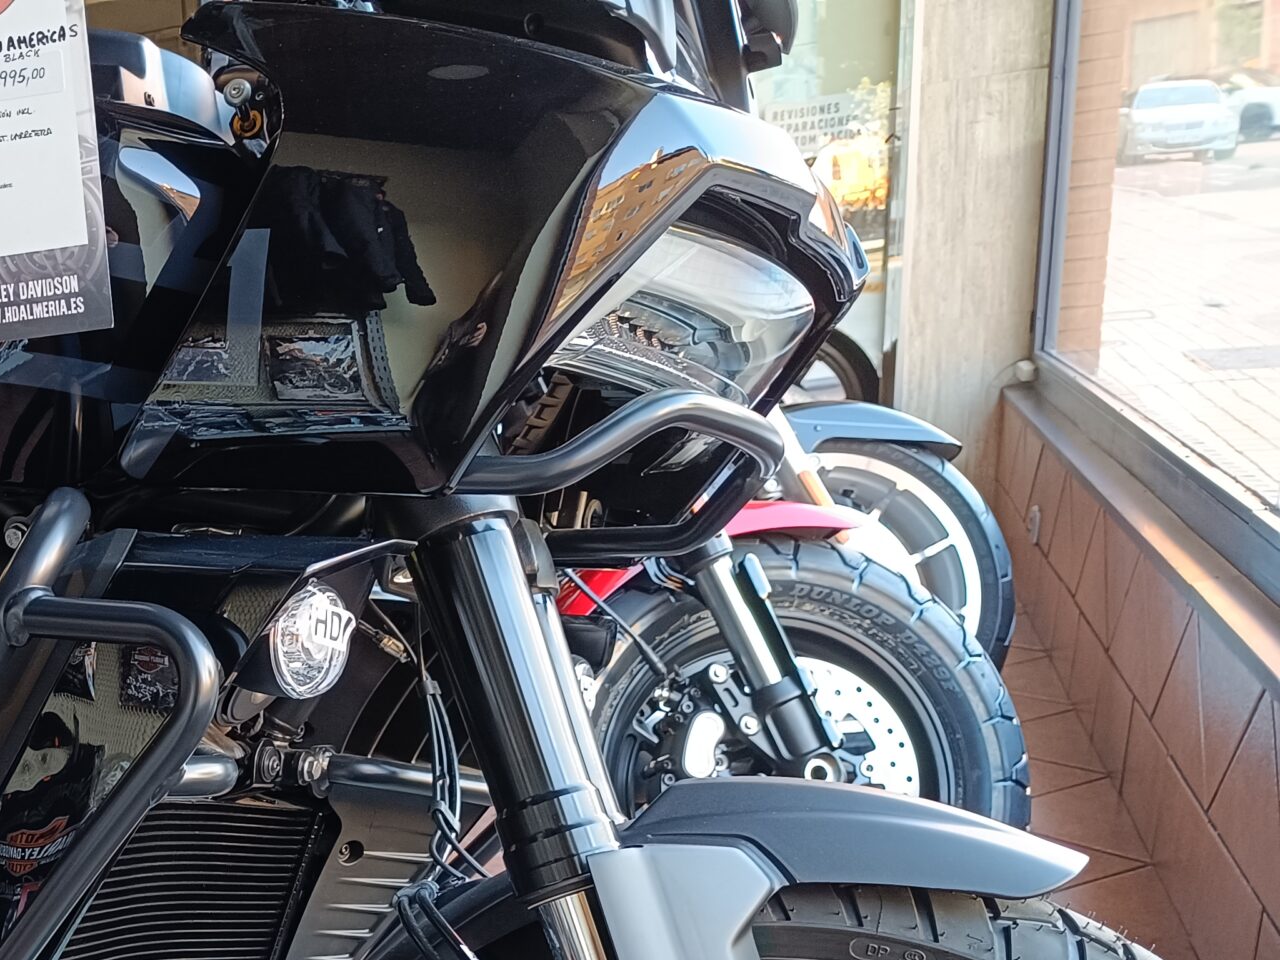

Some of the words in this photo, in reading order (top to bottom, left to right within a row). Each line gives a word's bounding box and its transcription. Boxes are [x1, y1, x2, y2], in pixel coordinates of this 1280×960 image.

[6, 25, 66, 51] AMERICA
[68, 24, 79, 38] S
[3, 48, 41, 63] BLACK
[19, 275, 79, 300] DAVIDSON
[790, 583, 897, 630] DUNLOP
